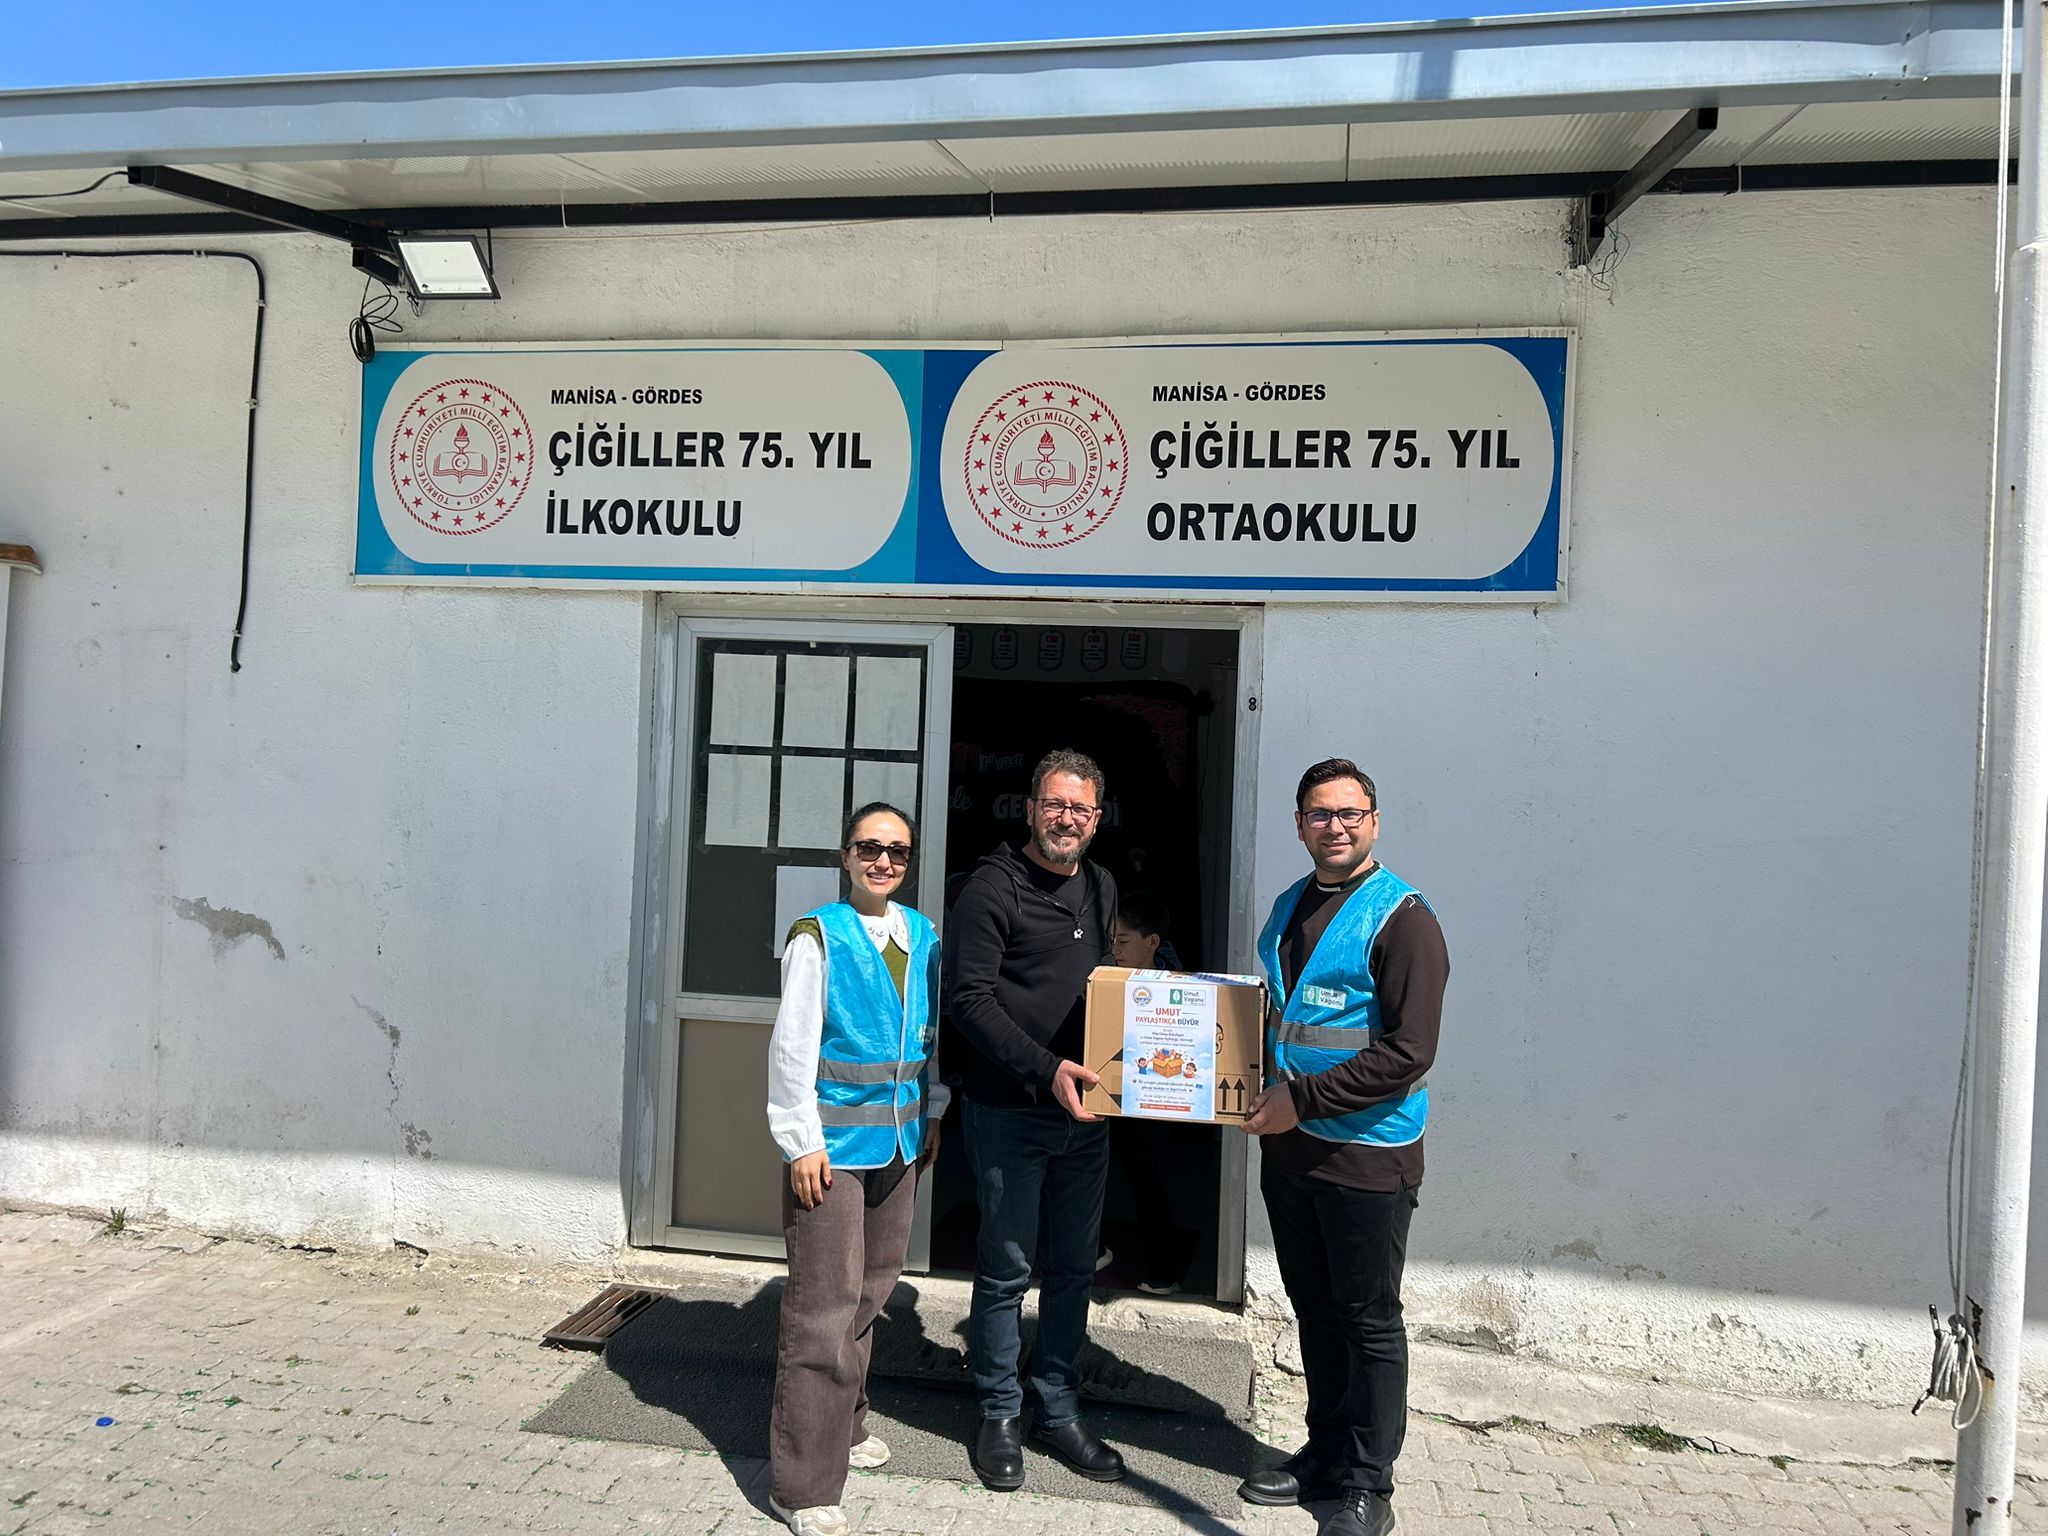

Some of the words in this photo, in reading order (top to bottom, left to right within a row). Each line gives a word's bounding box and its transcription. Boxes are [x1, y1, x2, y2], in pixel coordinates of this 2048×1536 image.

[551, 386, 617, 405] MANİSA
[632, 386, 703, 405] GÖRDES
[1152, 381, 1228, 402] MANİSA
[1246, 381, 1326, 402] GÖRDES
[460, 407, 487, 421] MİLLİ
[1044, 412, 1075, 427] MİLLİ
[416, 406, 458, 468] CUMHURİYETİ
[487, 418, 507, 453] EĞİTİM
[549, 422, 725, 477] ÇİĞİLLER
[738, 431, 794, 469] 75.
[808, 431, 872, 469] YIL
[994, 411, 1041, 476] CUMHURİYETİ
[1074, 424, 1097, 462] EĞİTİM
[1151, 420, 1352, 479] ÇİĞİLLER
[1367, 429, 1431, 469] 75.
[1447, 429, 1521, 469] YIL
[418, 471, 449, 505] TÜRKİYE
[469, 457, 507, 505] BAKANLIĞI
[997, 480, 1032, 516] TÜRKİYE
[1055, 466, 1097, 516] BAKANLIĞI
[546, 490, 742, 536] İLKOKULU
[1146, 502, 1417, 543] ORTAOKULU
[1135, 1016, 1176, 1025] PAYLAŞTIKÇA
[1177, 1018, 1200, 1026] BÜYÜR
[1155, 1007, 1181, 1016] UMUT
